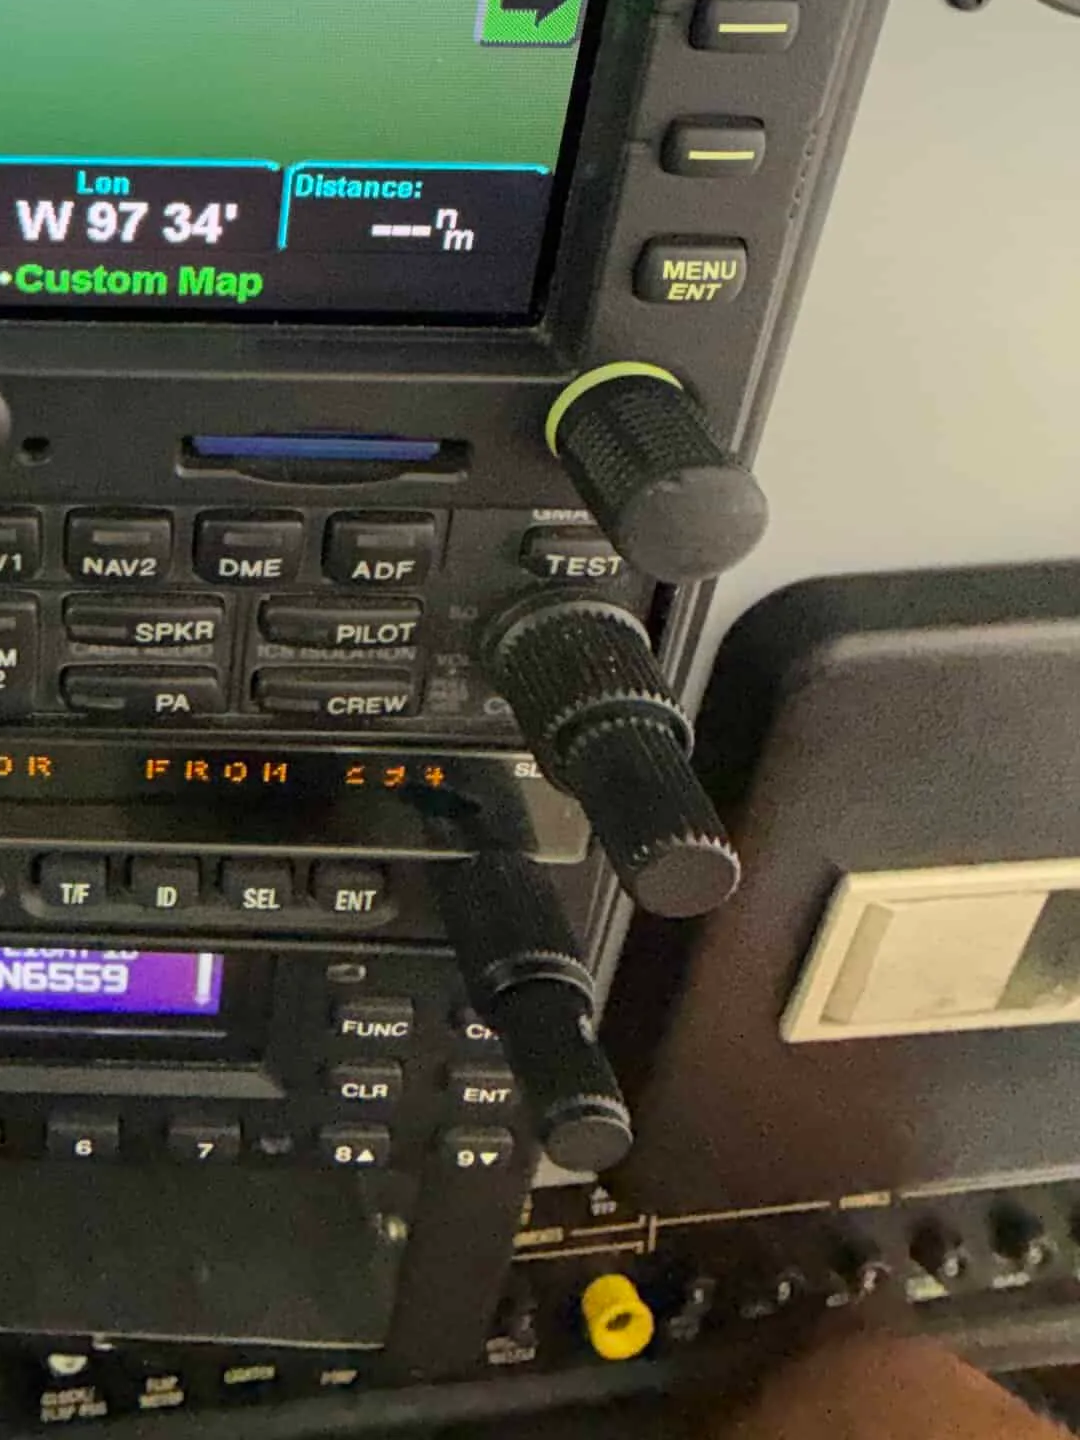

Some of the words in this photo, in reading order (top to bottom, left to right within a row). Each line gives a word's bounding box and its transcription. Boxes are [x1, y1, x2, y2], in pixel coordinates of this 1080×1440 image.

[77, 171, 129, 196] Lon
[295, 173, 422, 200] Distance:
[17, 201, 79, 241] W
[87, 201, 142, 242] 97
[663, 260, 737, 280] MENU
[15, 264, 168, 297] Custom
[179, 265, 263, 300] Map
[668, 283, 722, 300] ENT
[82, 556, 157, 578] NAV2
[219, 558, 282, 578] DME
[352, 561, 415, 582] ADF
[546, 554, 624, 577] TEST
[135, 621, 215, 643] SPKR
[335, 623, 416, 644] PILOT
[156, 694, 191, 713] PA
[327, 695, 408, 716] CREW
[60, 883, 90, 905] T/F
[156, 886, 177, 907] ID
[242, 888, 280, 910] SEL
[335, 889, 376, 911] ENT
[342, 1021, 409, 1038] FUNC
[341, 1083, 388, 1099] CLR
[463, 1088, 510, 1105] ENT
[75, 1139, 92, 1157] 6
[197, 1143, 214, 1159] 7
[335, 1146, 352, 1162] 8
[457, 1150, 474, 1168] 9
